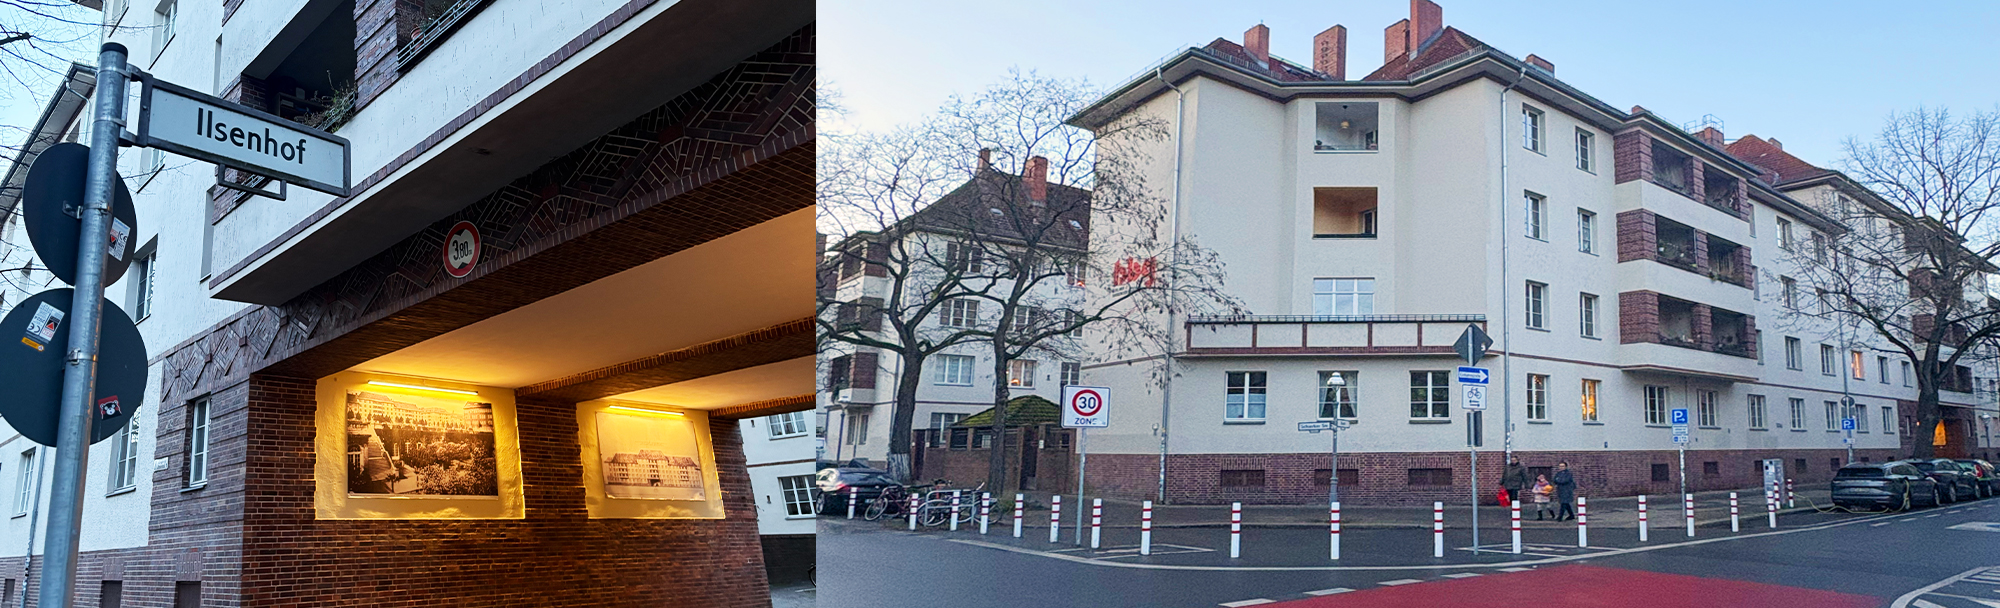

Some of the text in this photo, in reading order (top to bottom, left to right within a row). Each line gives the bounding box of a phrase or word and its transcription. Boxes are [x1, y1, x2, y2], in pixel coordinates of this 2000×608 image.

[197, 107, 307, 165] Ilsenhof
[1078, 396, 1097, 410] 30
[1074, 417, 1098, 425] ZONE
